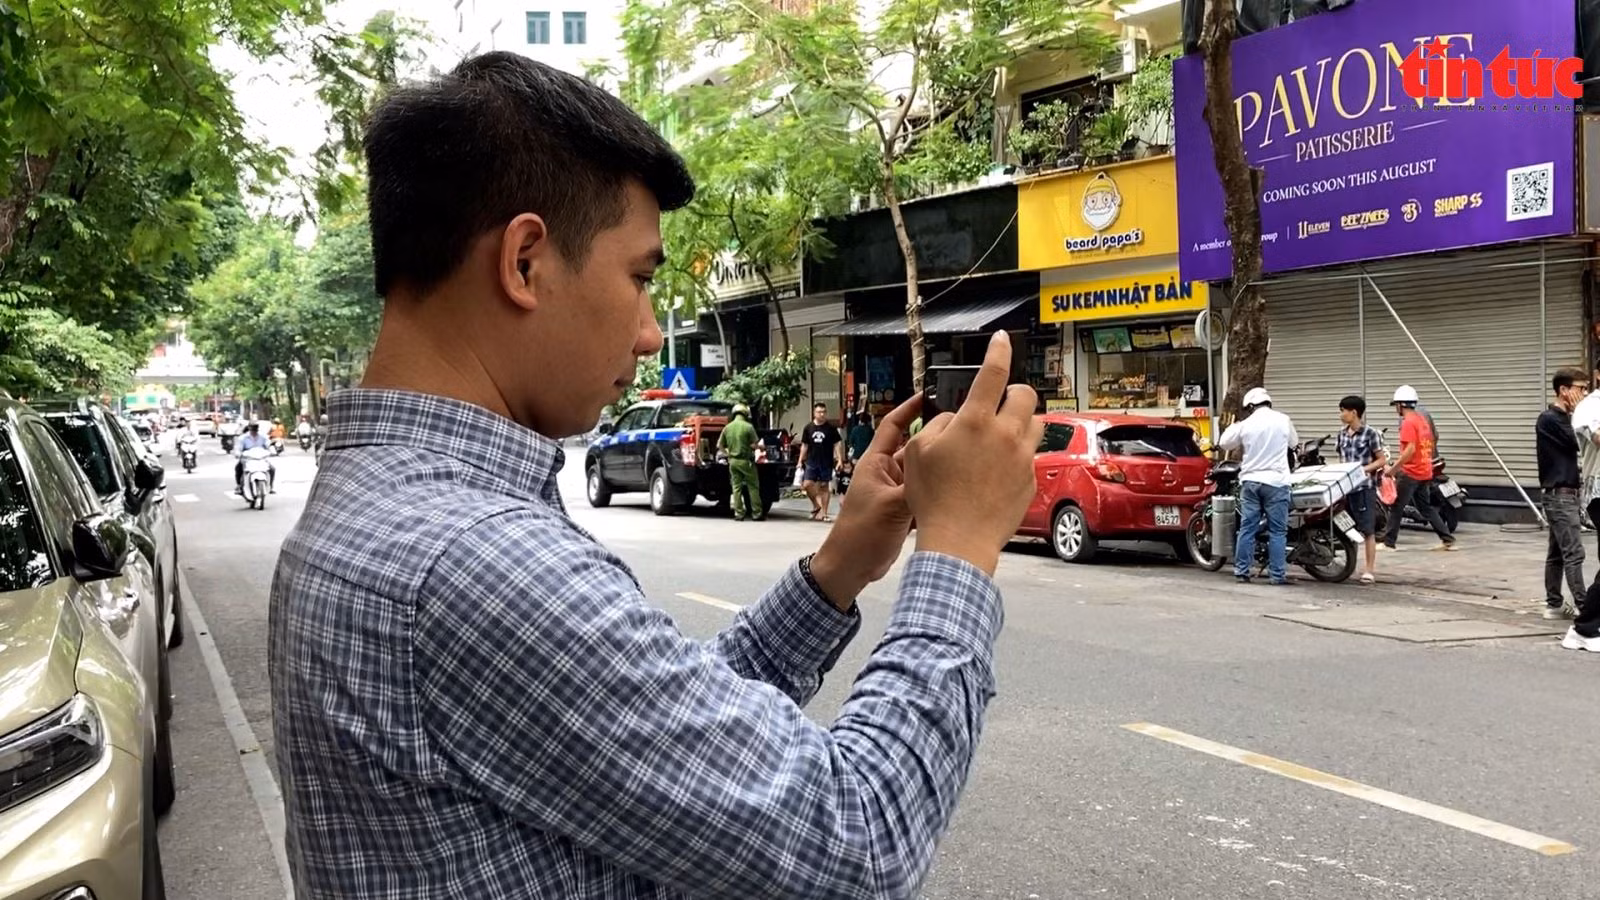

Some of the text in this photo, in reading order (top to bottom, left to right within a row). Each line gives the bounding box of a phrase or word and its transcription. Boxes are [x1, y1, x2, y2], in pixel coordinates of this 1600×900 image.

[1295, 121, 1395, 163] PATISSERIE
[1263, 158, 1437, 204] COMING SOON THIS AUGUST
[1434, 194, 1468, 213] SHARP
[1065, 231, 1140, 249] beard papa's
[1192, 242, 1199, 252] A
[1200, 238, 1225, 251] member
[1261, 232, 1278, 242] roup
[1154, 275, 1192, 301] BẢN
